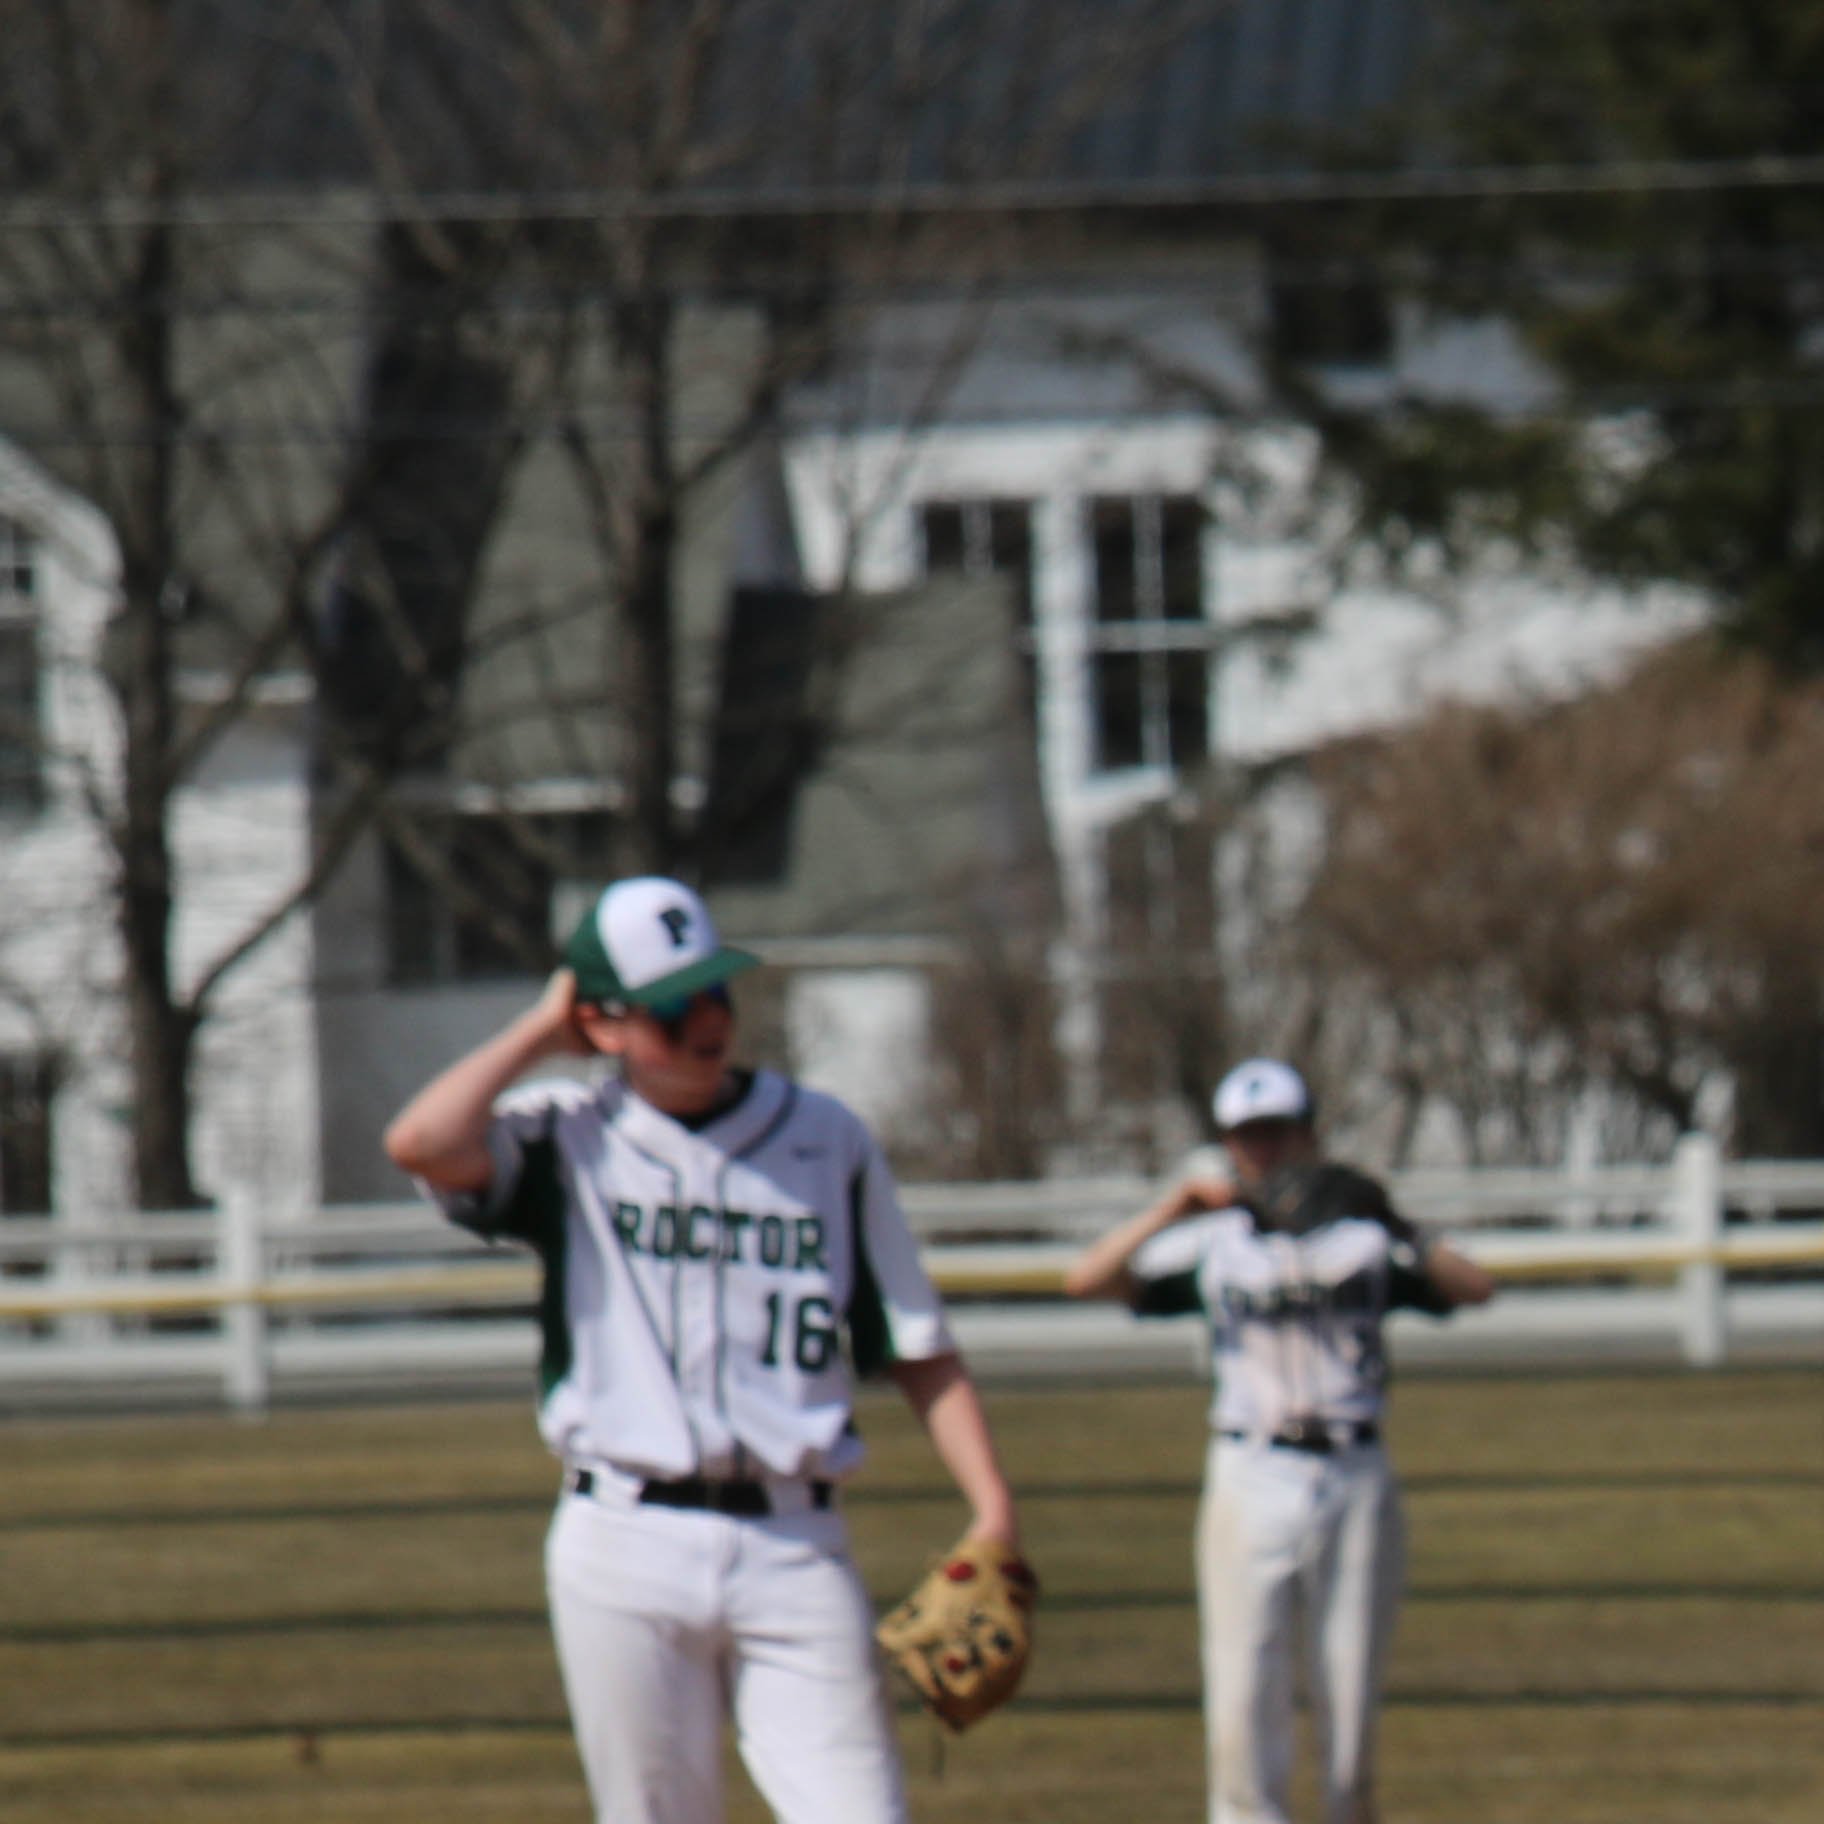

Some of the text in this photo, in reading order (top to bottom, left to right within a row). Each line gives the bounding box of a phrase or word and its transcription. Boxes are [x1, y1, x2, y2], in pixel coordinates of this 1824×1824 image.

[658, 907, 690, 946] P
[612, 1202, 829, 1273] ROCTOR
[761, 1289, 839, 1377] 16
